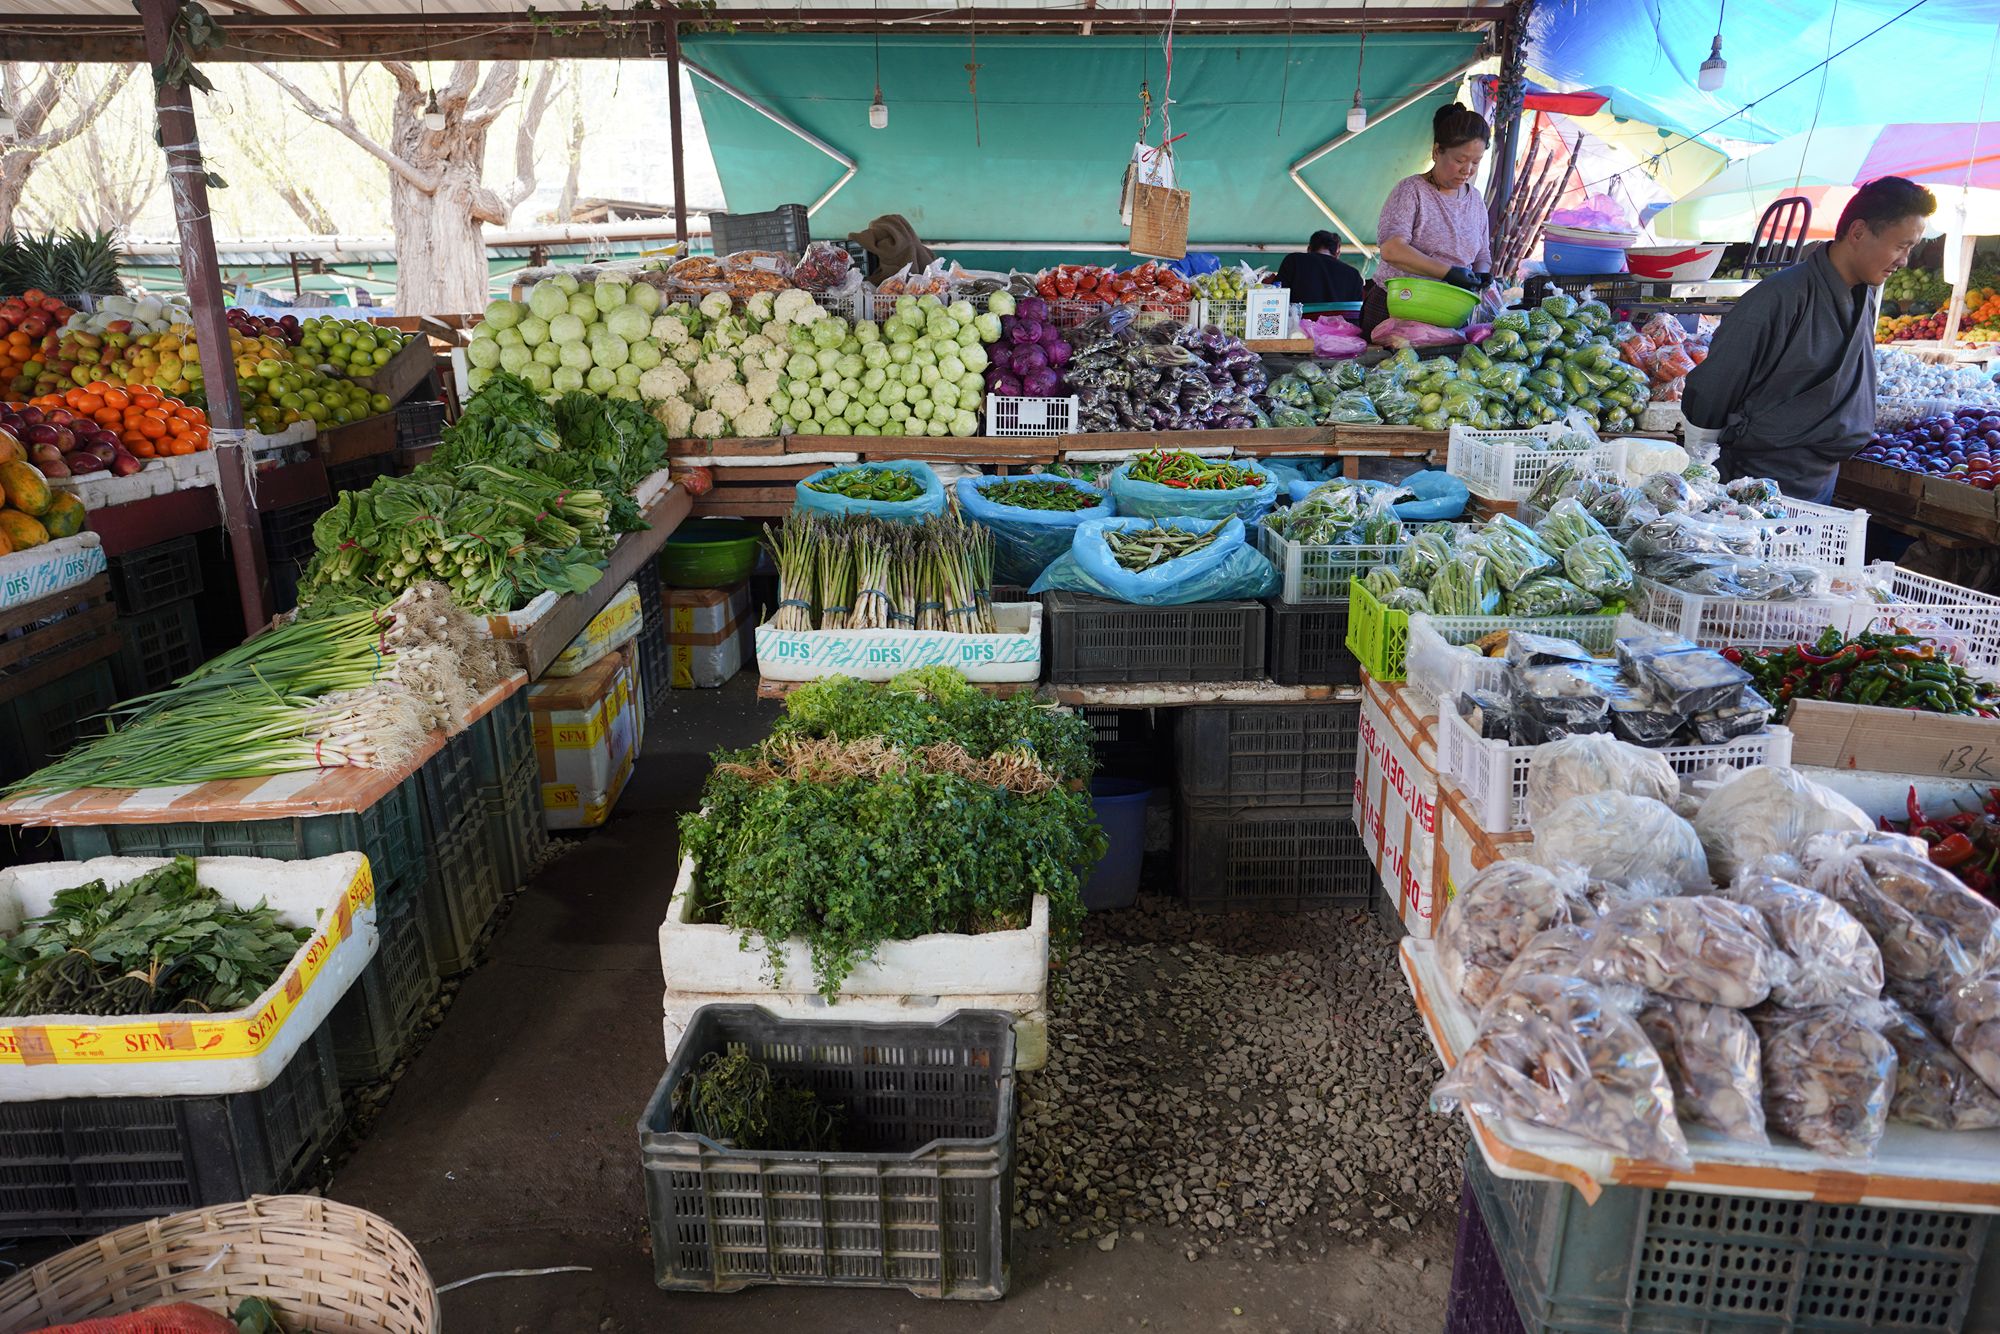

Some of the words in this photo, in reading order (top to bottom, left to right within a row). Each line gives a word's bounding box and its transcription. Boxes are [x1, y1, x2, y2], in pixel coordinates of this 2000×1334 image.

[6, 576, 30, 597] DFS
[65, 559, 85, 578] DFS
[778, 640, 811, 659] DFS
[869, 647, 901, 663] DFS
[962, 644, 995, 661] DFS
[559, 730, 587, 743] SFM
[1380, 742, 1405, 798] DEVI
[124, 1032, 176, 1052] SFM
[247, 1003, 278, 1046] SFM
[306, 933, 330, 971] SFM
